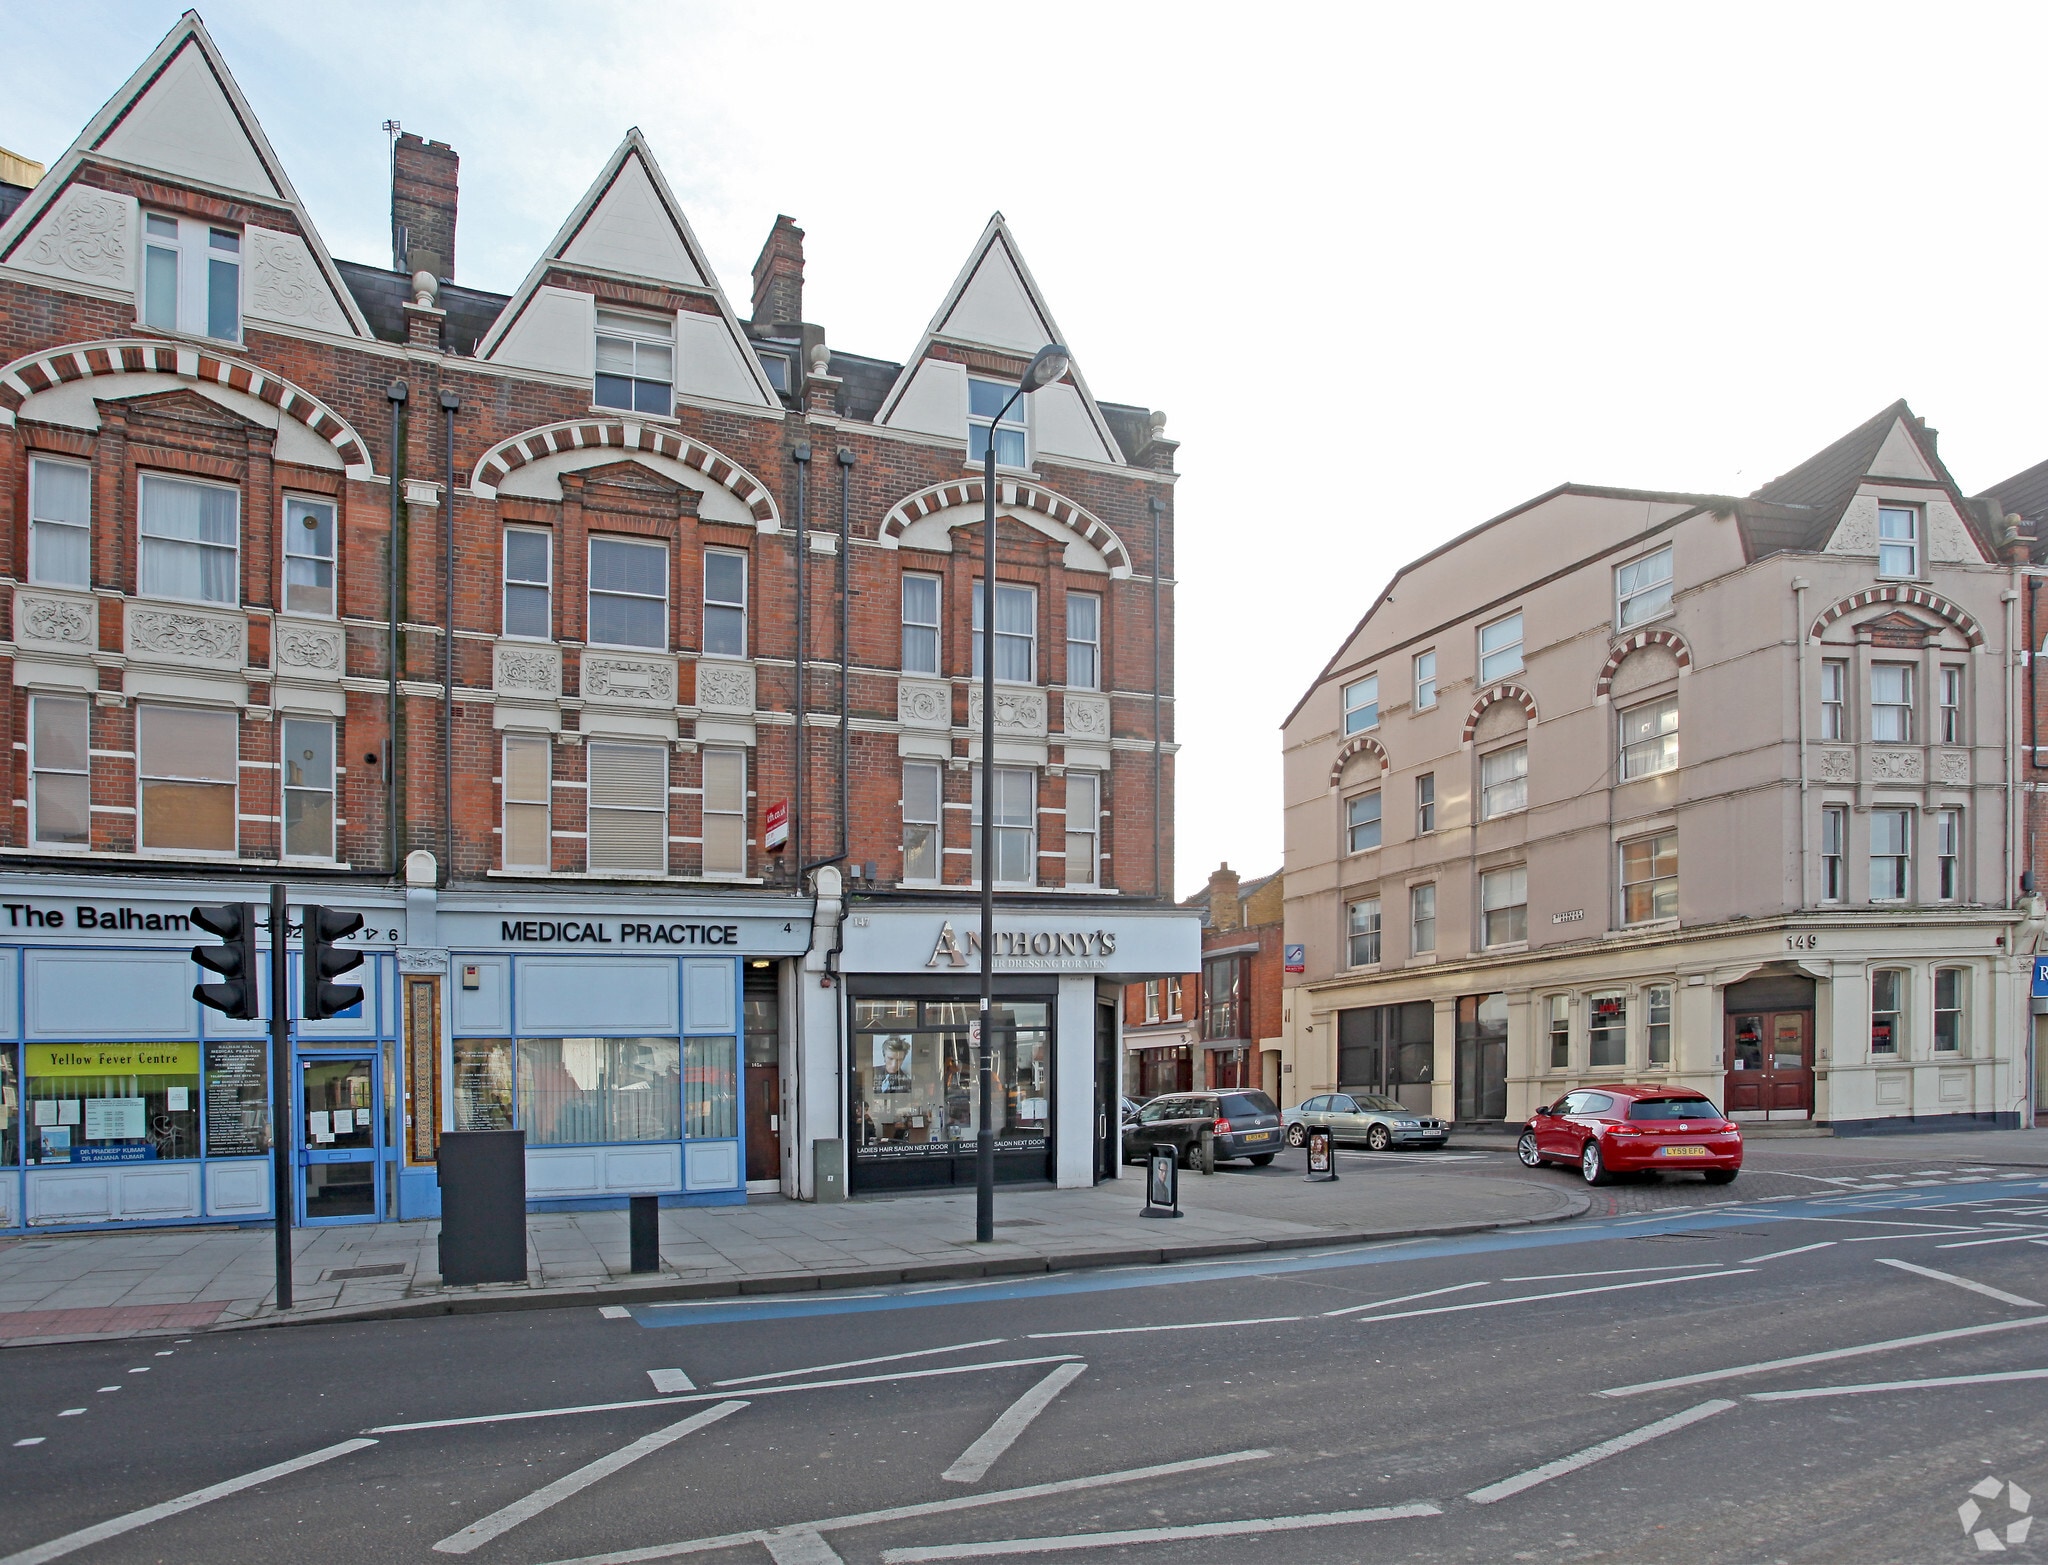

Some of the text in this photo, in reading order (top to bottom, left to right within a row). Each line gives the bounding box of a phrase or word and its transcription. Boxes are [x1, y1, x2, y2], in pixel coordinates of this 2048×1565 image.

[2, 904, 190, 931] The Balham
[854, 917, 870, 927] 147
[501, 921, 738, 945] MEDICAL PRACTICE
[1786, 934, 1817, 950] 149
[1008, 959, 1058, 969] DRESSING
[1061, 959, 1083, 969] FOR
[1084, 960, 1106, 969] MEN
[51, 1053, 178, 1065] Yellow Fever Centre
